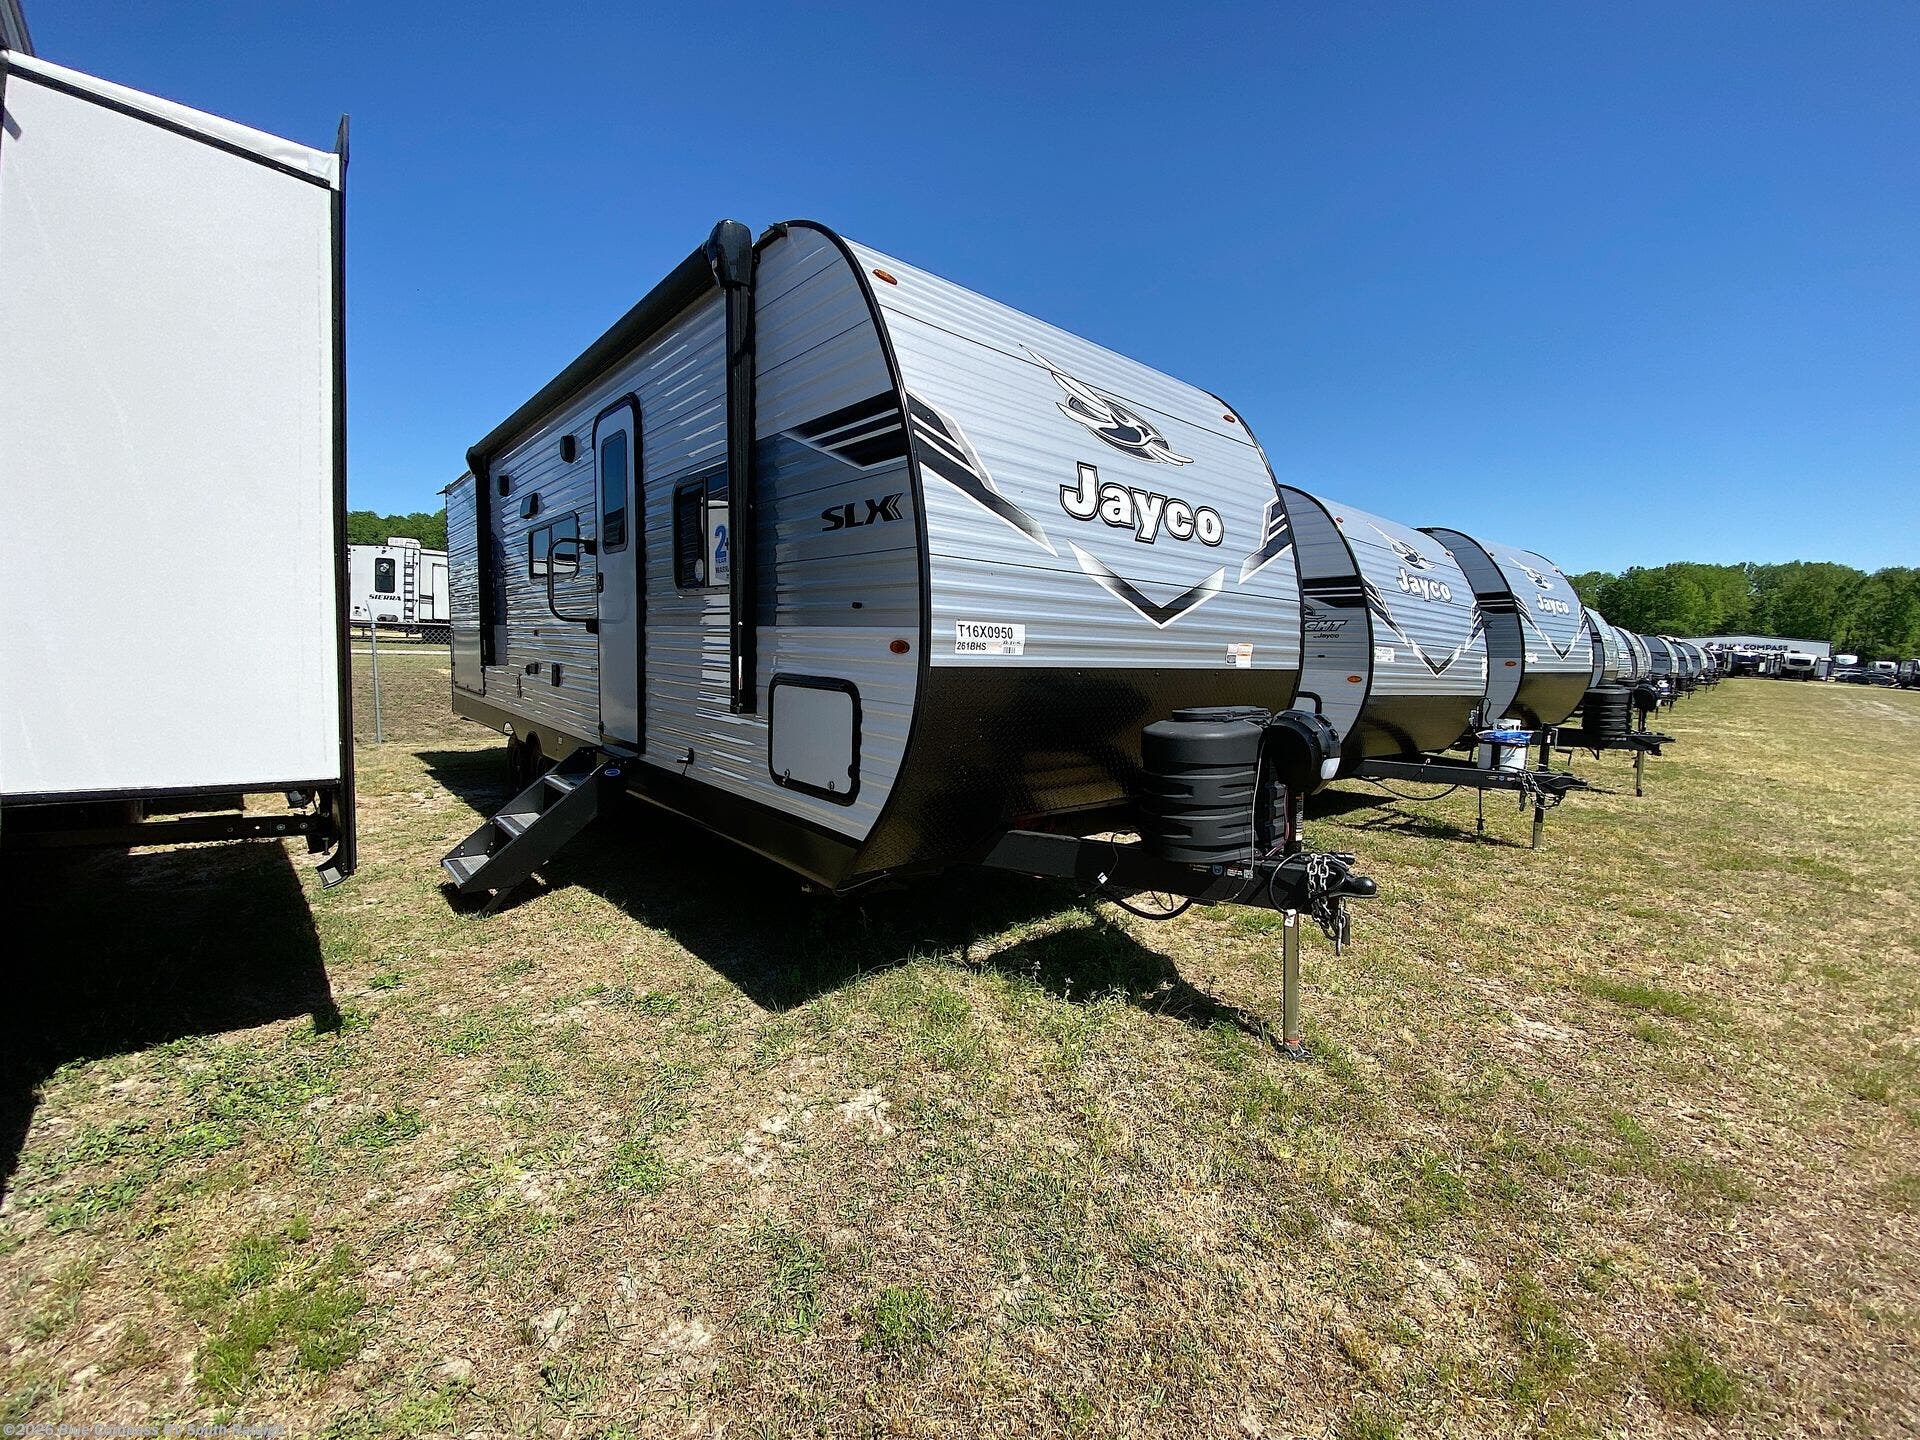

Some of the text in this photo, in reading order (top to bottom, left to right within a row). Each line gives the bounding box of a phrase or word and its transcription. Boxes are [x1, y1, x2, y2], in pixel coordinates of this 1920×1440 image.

[821, 492, 904, 532] SLX
[1059, 461, 1224, 547] Jayco
[1396, 566, 1452, 603] Jayco
[369, 593, 401, 601] SIERRA
[1536, 592, 1570, 616] Jayco
[957, 624, 1013, 640] T16X0950
[1304, 620, 1348, 631] GHT
[956, 641, 987, 651] 261BHS
[1743, 643, 1788, 651] COMPASS
